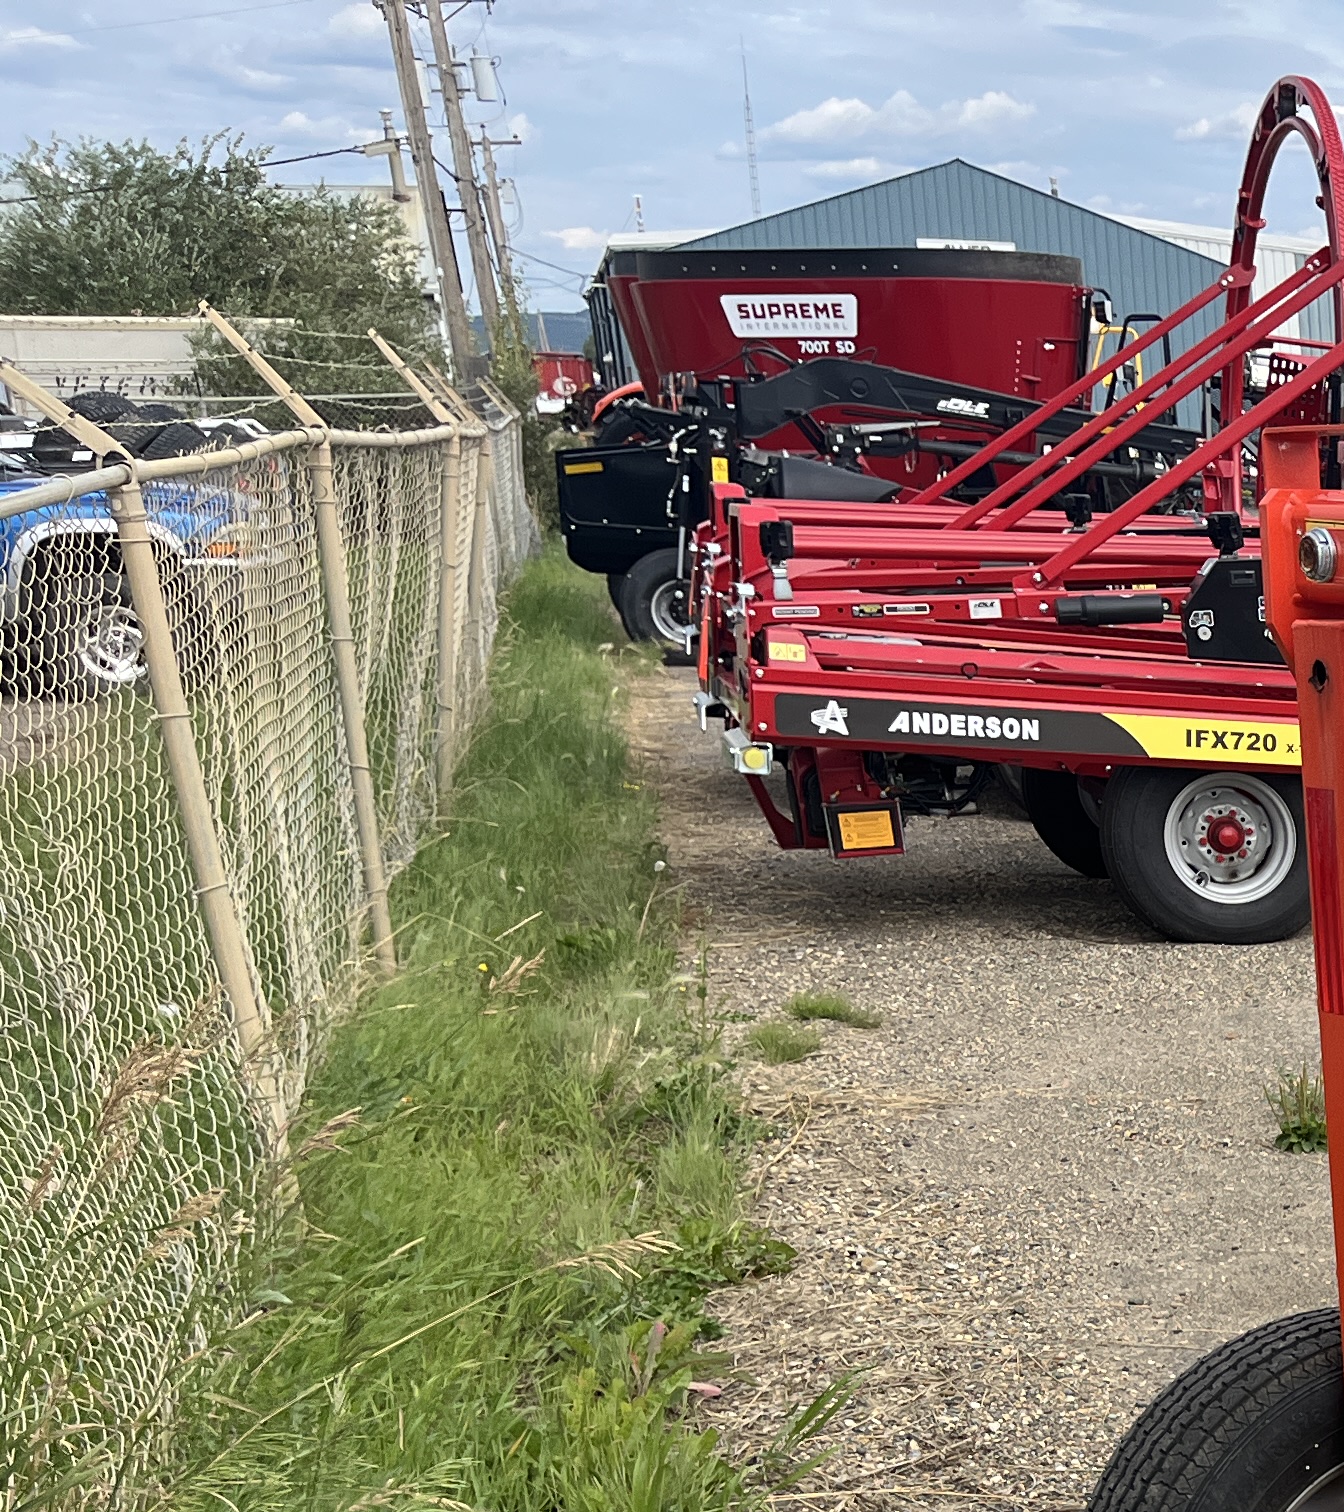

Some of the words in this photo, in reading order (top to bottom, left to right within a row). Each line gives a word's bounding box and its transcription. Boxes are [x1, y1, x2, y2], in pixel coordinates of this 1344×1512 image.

[737, 303, 845, 319] SUPREME
[740, 322, 849, 331] INTERNATIONAL
[798, 341, 830, 354] 700T
[835, 341, 856, 354] SD
[887, 711, 1040, 741] ANDERSON
[1186, 729, 1277, 752] IFX720
